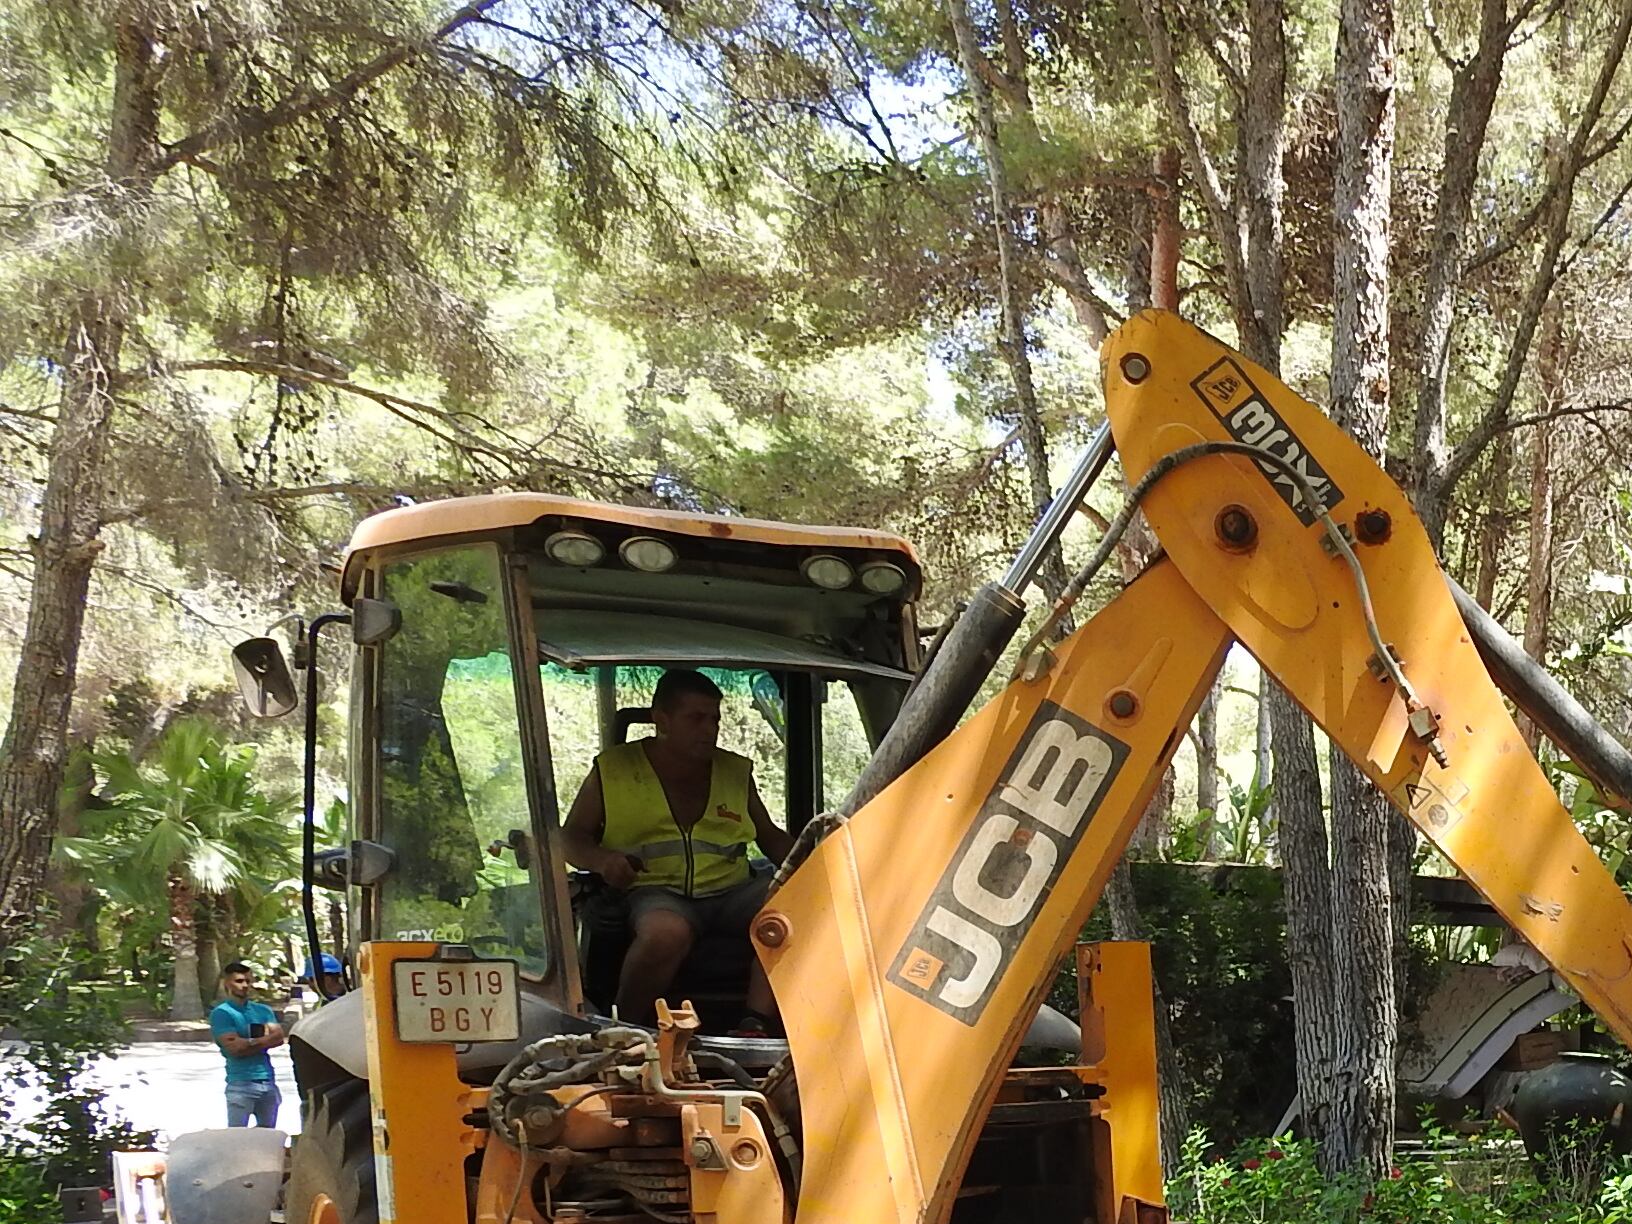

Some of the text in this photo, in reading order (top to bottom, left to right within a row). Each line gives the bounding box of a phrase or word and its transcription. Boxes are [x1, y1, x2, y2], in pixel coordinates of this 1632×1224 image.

[1212, 377, 1239, 400] JCB
[926, 719, 1113, 1009] JCB
[411, 970, 503, 997] E 5119
[430, 1007, 494, 1032] BGY
